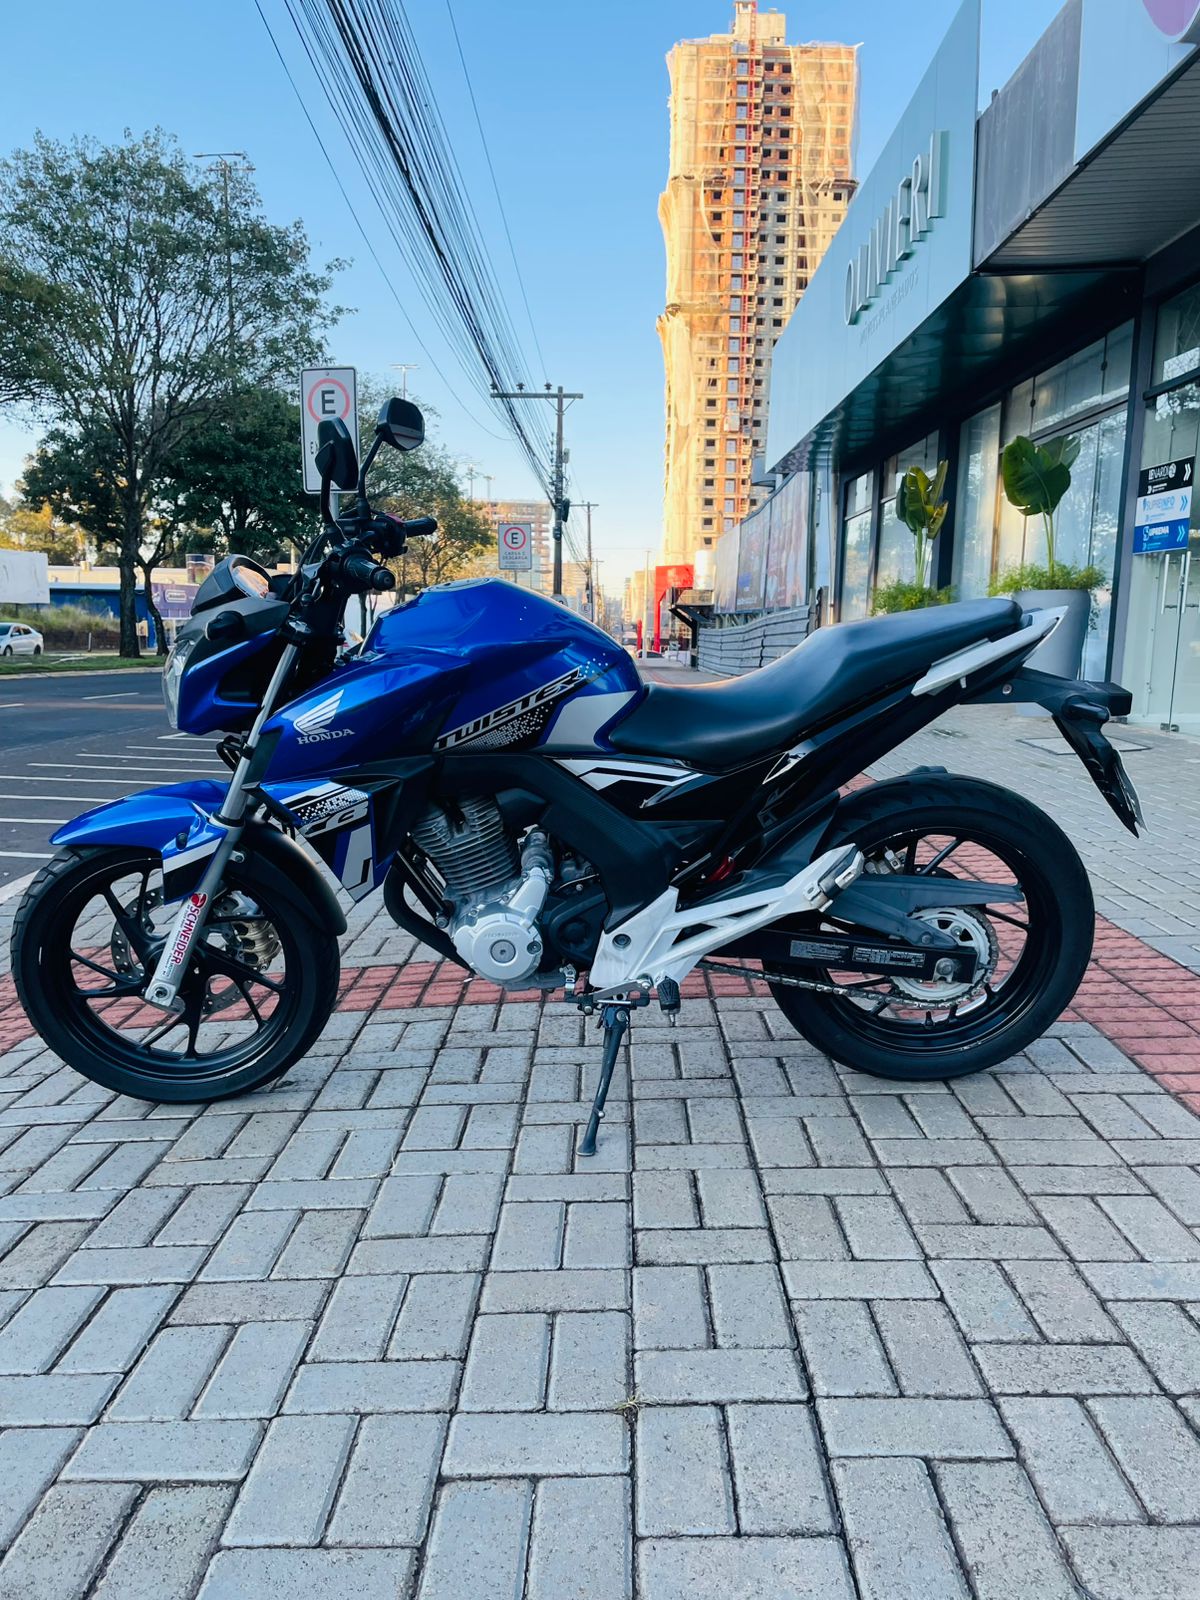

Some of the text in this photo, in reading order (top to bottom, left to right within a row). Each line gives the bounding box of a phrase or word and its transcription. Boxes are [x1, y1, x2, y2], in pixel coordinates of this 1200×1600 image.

[844, 131, 944, 325] OLIVIERI
[321, 389, 336, 414] E
[511, 532, 519, 544] E
[434, 665, 583, 751] TWISTER
[296, 728, 356, 745] HONDA
[171, 905, 200, 965] SCHNEIDER
